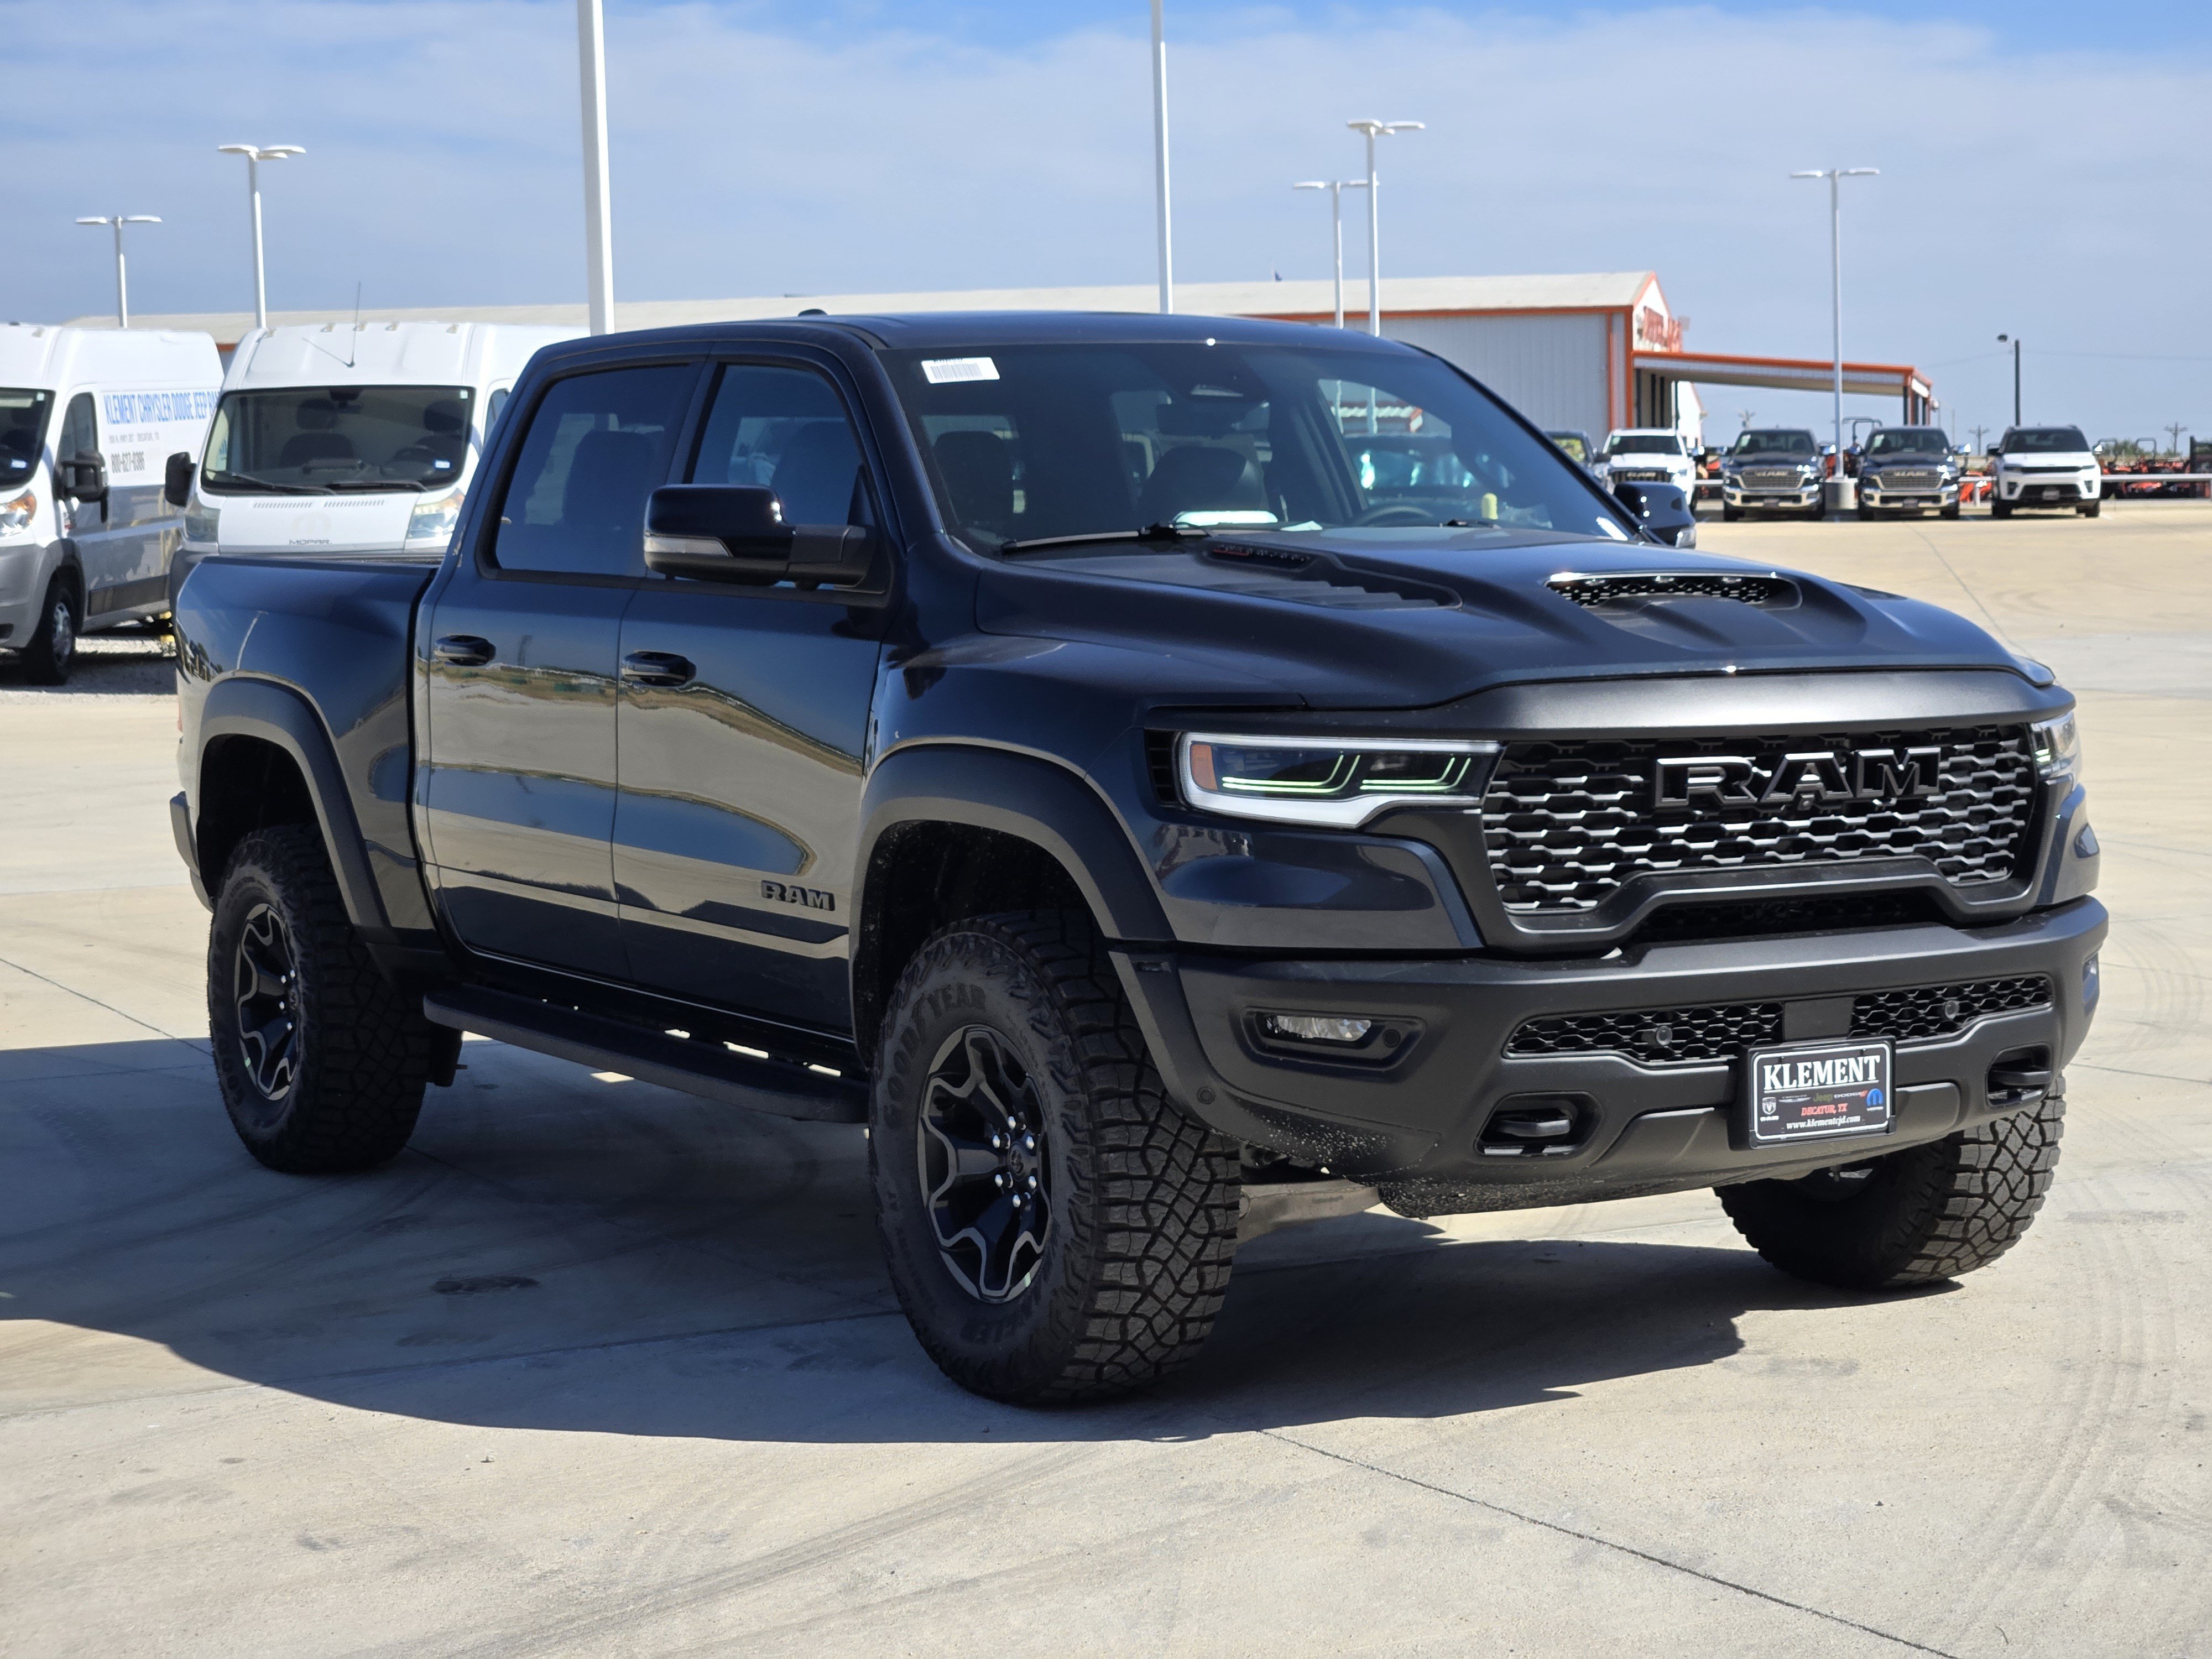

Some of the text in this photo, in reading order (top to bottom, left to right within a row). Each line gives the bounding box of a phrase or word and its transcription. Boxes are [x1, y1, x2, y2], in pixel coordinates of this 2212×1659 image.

[103, 394, 138, 425] KLEMENT
[138, 393, 173, 423] CHRYSLER
[171, 392, 194, 421] DODGE
[194, 392, 207, 419] JEEP
[1655, 747, 1940, 807] RAM
[761, 880, 836, 911] RAM
[1764, 1055, 1880, 1091] KLEMENT
[1801, 1103, 1849, 1116] DECATUR, TX
[1813, 1093, 1833, 1102] Jeep
[1786, 1115, 1861, 1129] www.klementcjd.com
